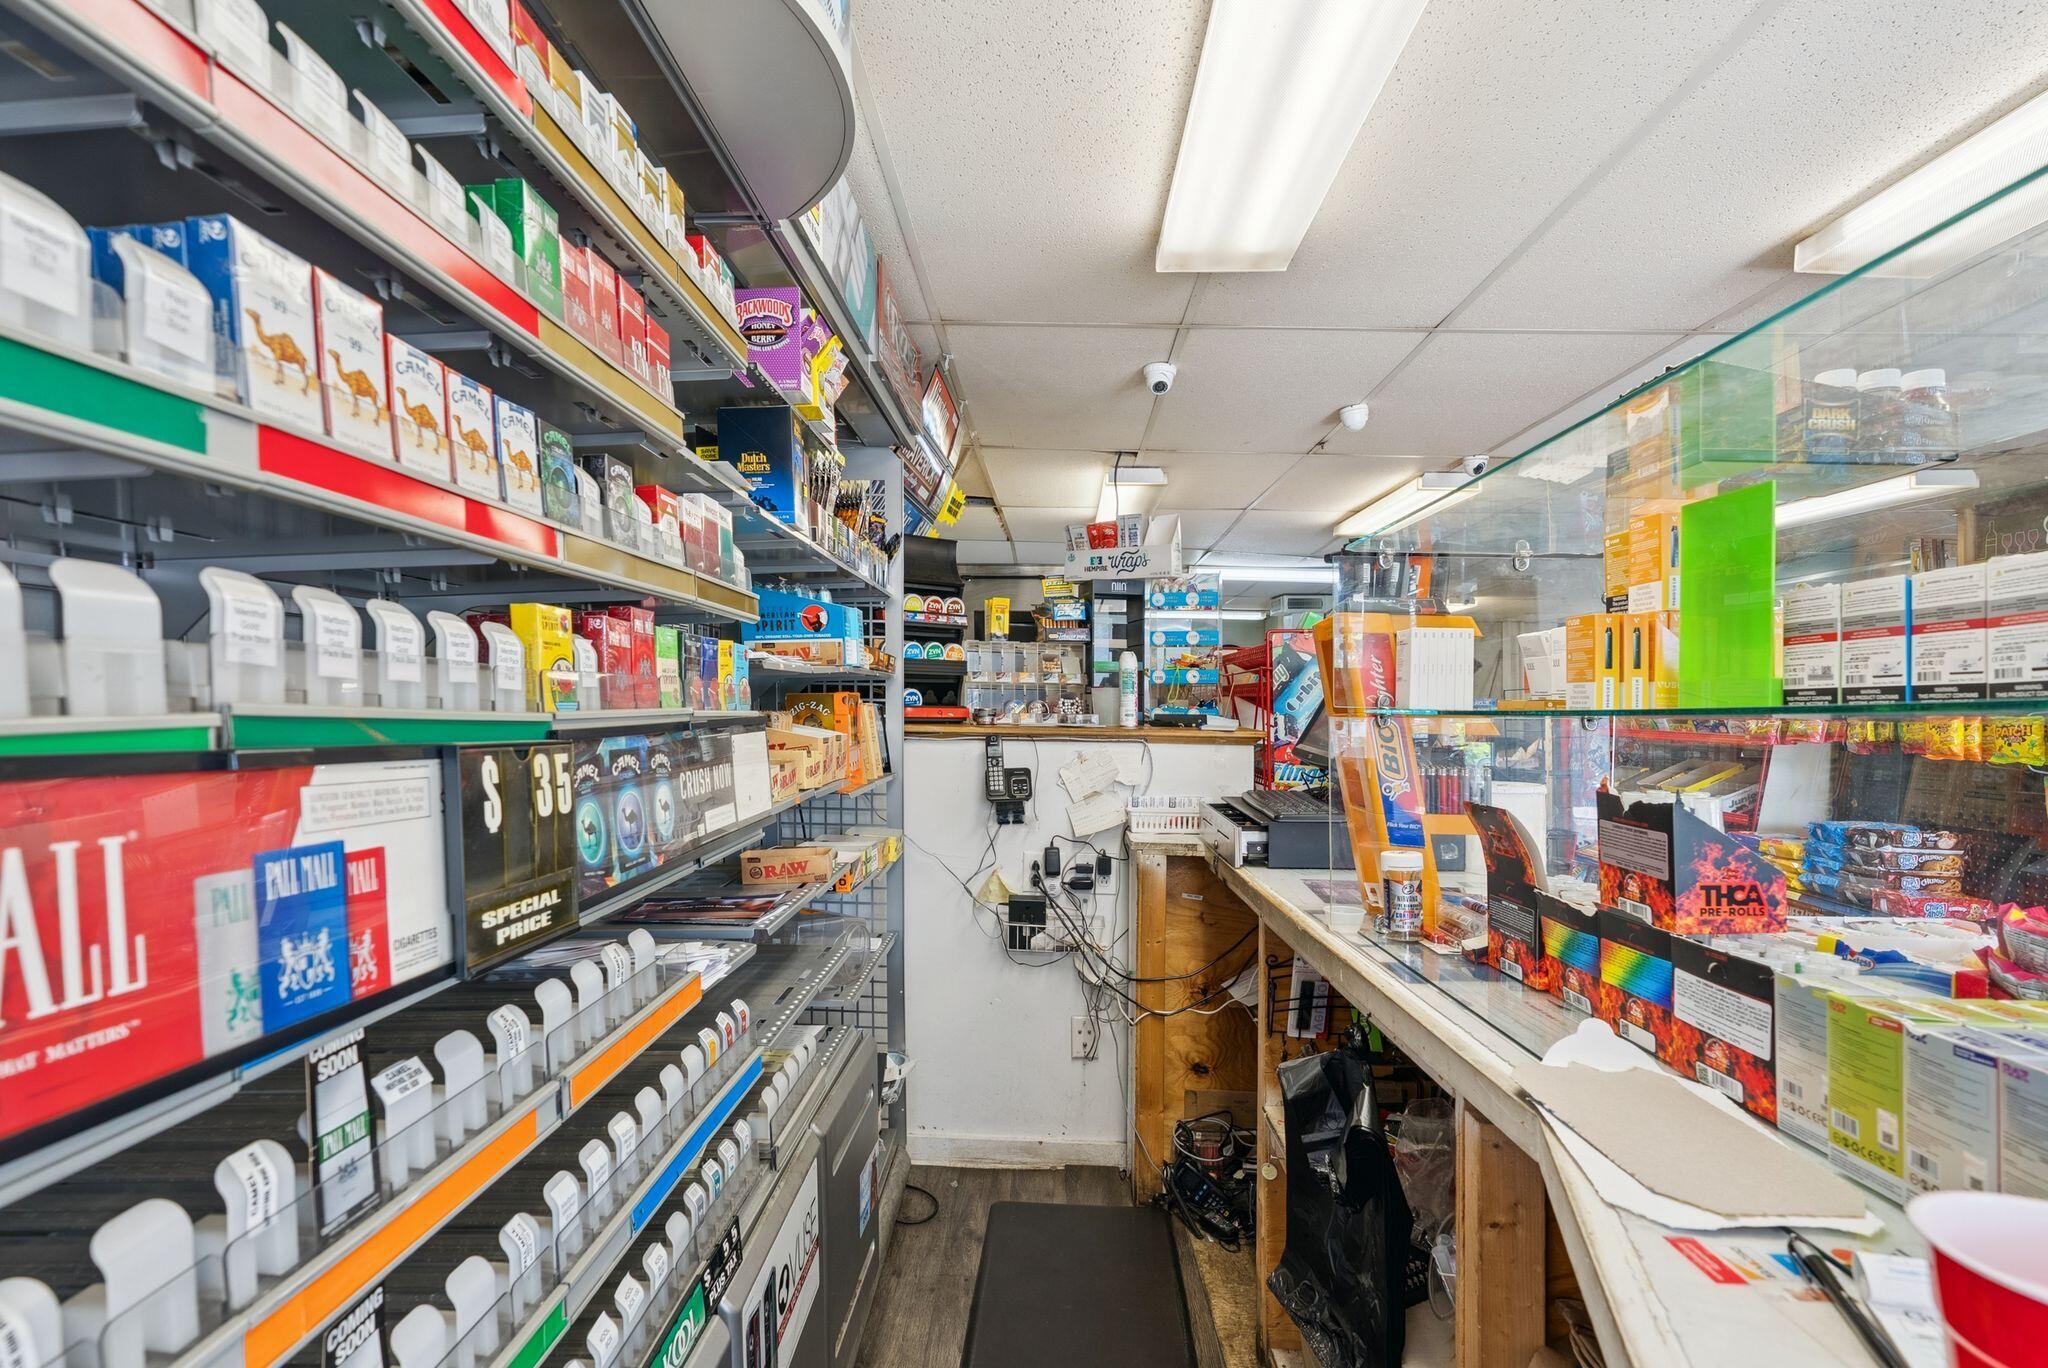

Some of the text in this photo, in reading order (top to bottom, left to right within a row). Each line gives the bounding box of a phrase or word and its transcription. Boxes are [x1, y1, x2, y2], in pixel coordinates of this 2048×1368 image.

[736, 299, 792, 325] BACKWOODS
[751, 322, 775, 330] HONEY
[751, 335, 776, 343] BERRY
[396, 360, 442, 397] CAMEL
[451, 388, 491, 421] CAMEL
[1812, 408, 1851, 418] DARK
[501, 416, 535, 442] CAMEL
[1807, 419, 1856, 429] CRUSH
[544, 430, 571, 450] CAMEL
[737, 462, 771, 472] Masters
[741, 453, 767, 463] Dutch
[610, 464, 632, 483] CAMEL
[1090, 556, 1103, 565] E3
[755, 619, 796, 632] SPIRIT
[790, 701, 831, 716] ZIG-ZAG
[1995, 724, 2033, 738] PATCH
[612, 754, 641, 776] CAMEL
[651, 753, 672, 772] CAMEL
[574, 764, 600, 788] CAMEL
[679, 762, 732, 800] CRUSH NOW
[781, 769, 796, 789] RAW
[482, 753, 572, 834] $ 35
[265, 851, 338, 902] PALL MALL
[347, 857, 380, 896] MALL
[763, 861, 808, 878] RAW
[1700, 885, 1764, 906] THCA
[482, 889, 562, 929] SPECIAL
[1700, 907, 1765, 917] PRE-ROLLS
[496, 911, 552, 945] PRICE
[317, 1044, 358, 1082] SOON
[385, 1064, 413, 1082] CAMEL
[709, 1253, 738, 1306] PLUS TAX
[326, 1286, 384, 1353] COMING
[334, 1312, 376, 1366] SOON
